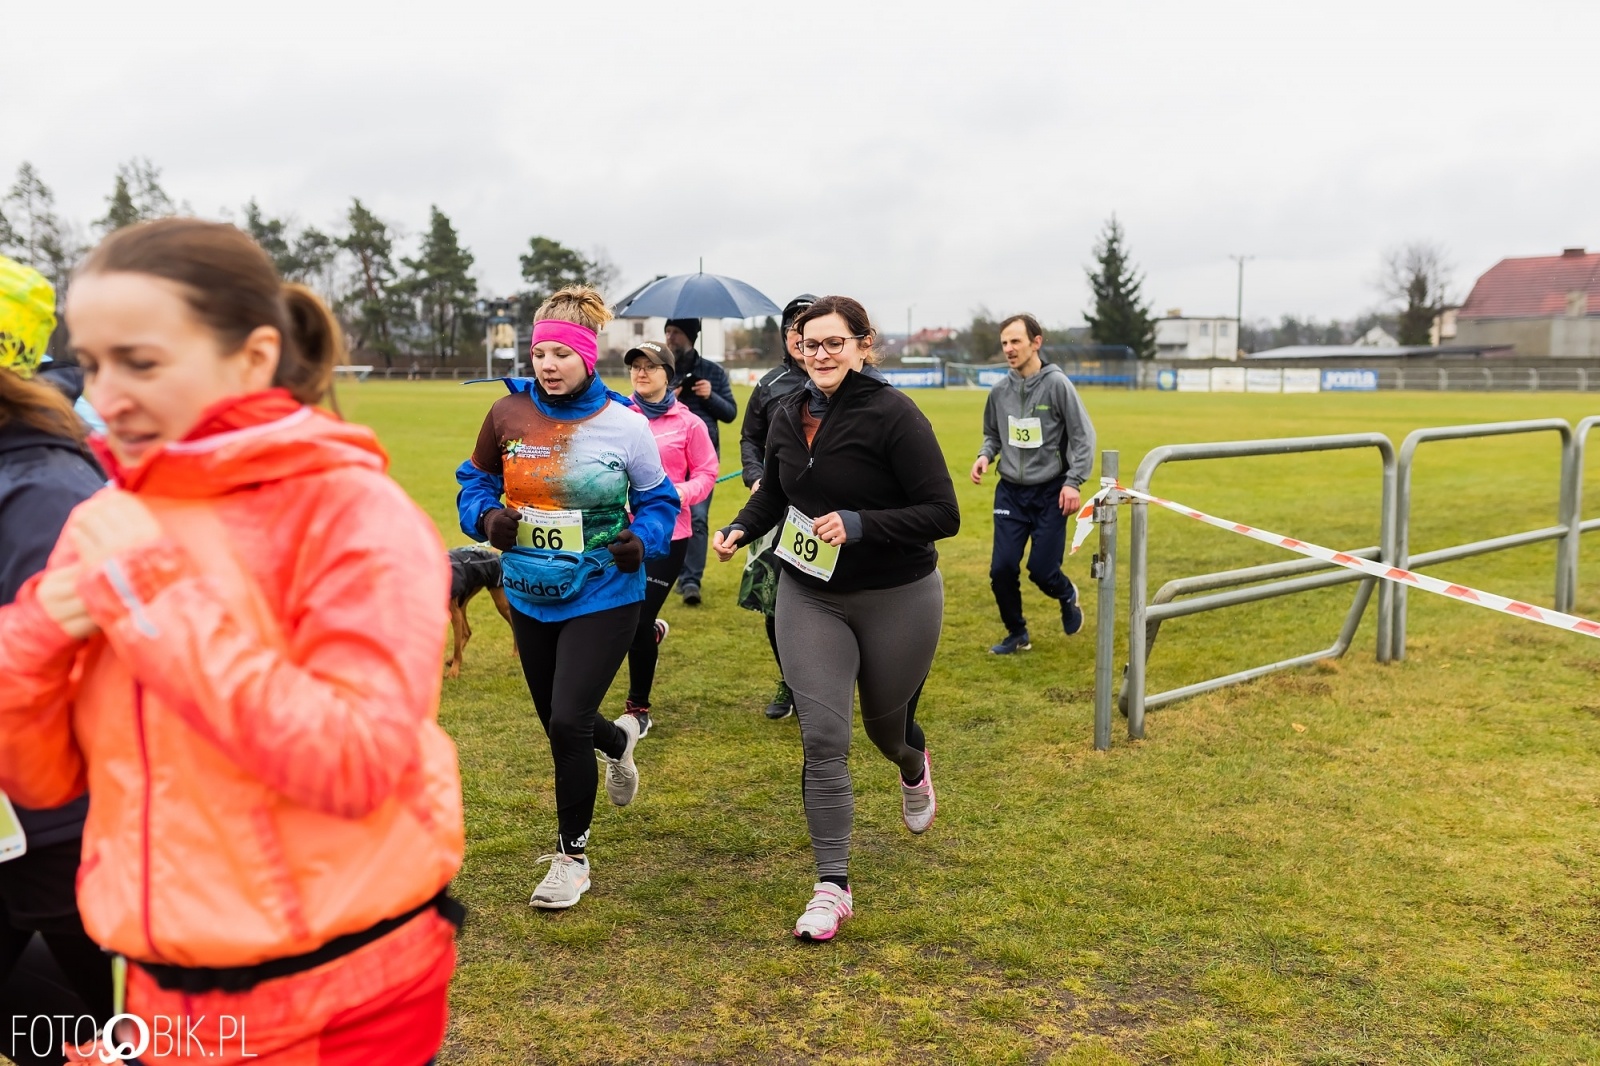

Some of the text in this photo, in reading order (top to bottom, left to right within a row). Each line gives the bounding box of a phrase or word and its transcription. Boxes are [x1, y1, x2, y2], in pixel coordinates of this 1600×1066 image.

[1016, 428, 1030, 442] 53
[532, 526, 563, 550] 66
[793, 531, 819, 563] 89
